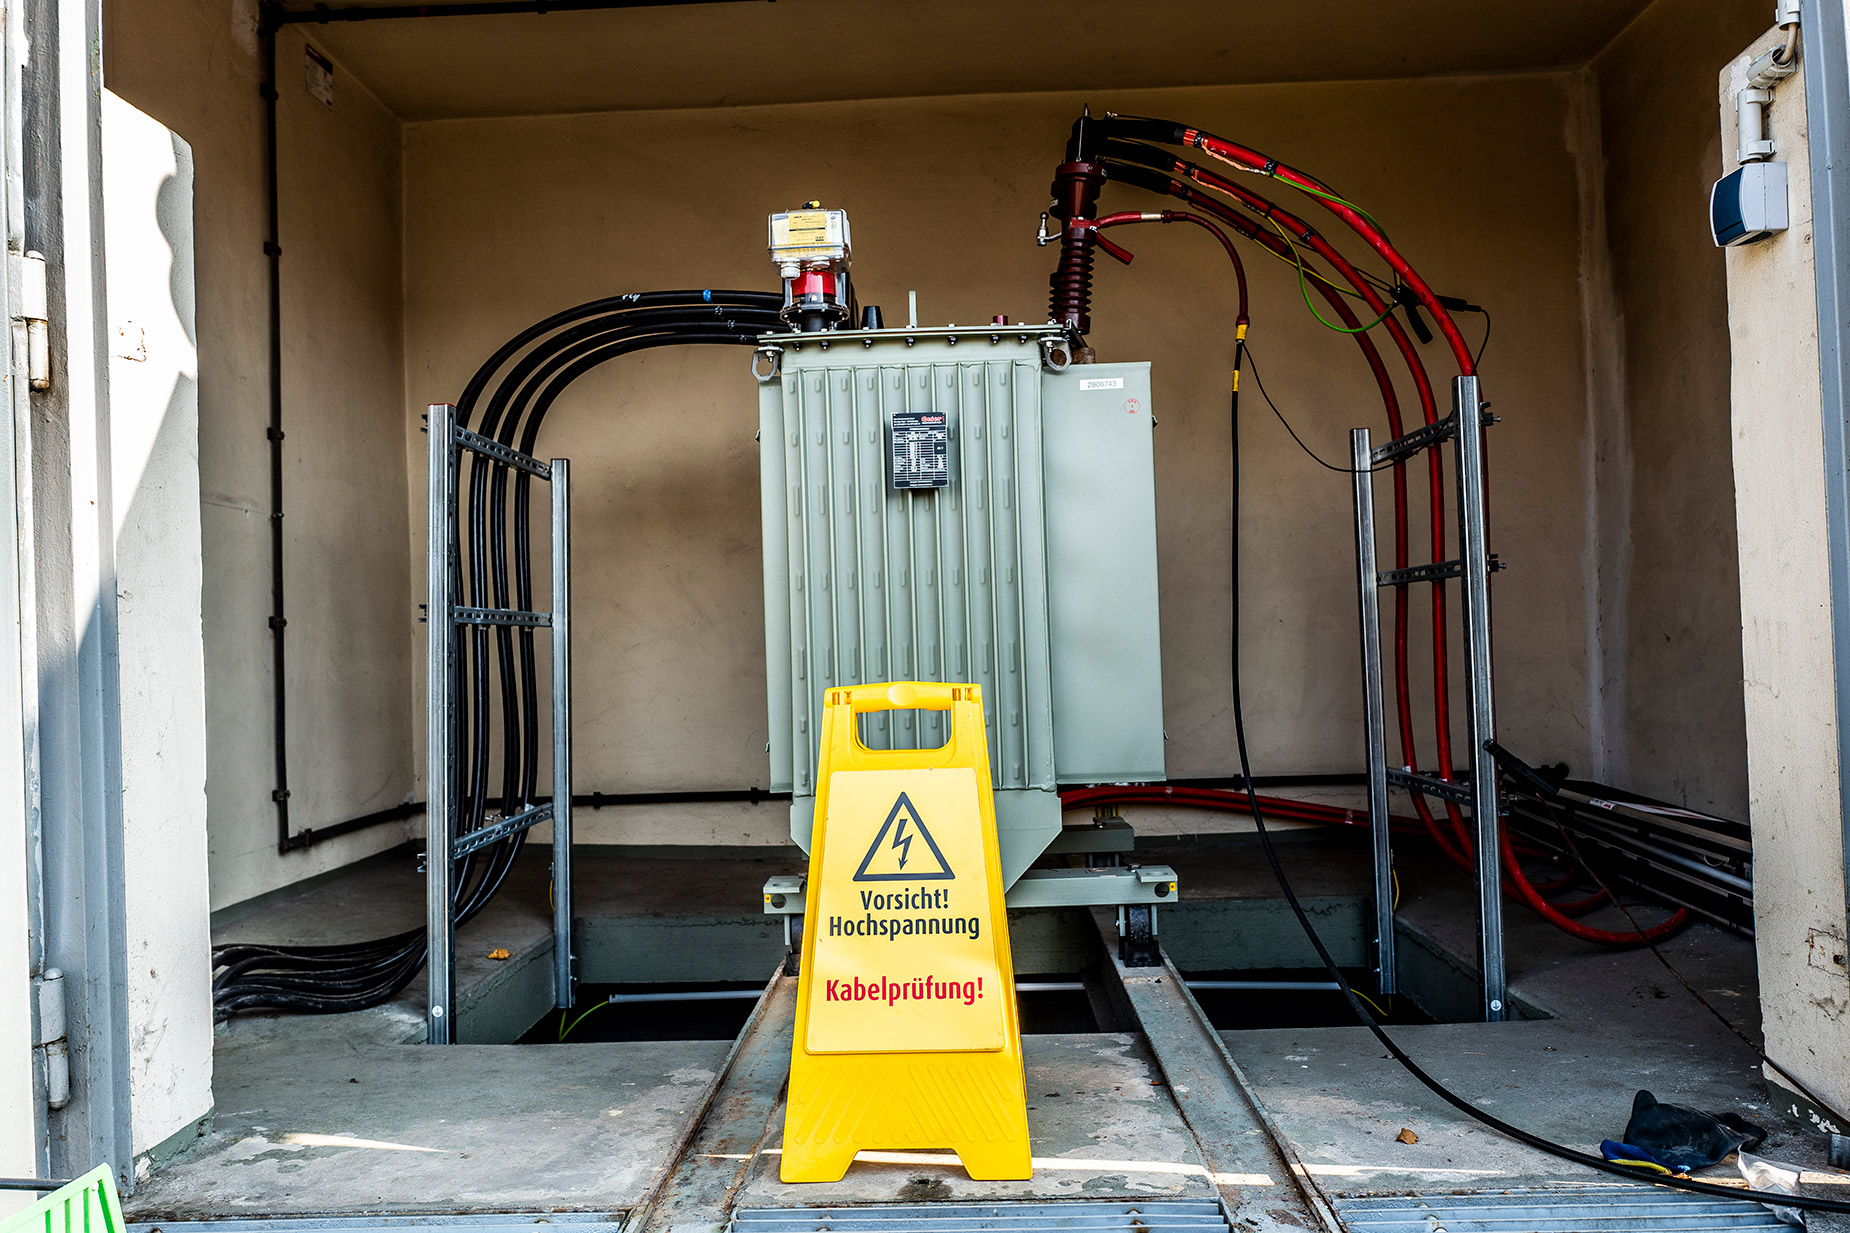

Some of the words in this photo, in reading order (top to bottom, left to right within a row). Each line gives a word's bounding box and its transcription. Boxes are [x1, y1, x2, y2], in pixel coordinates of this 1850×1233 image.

[860, 887, 949, 910] Vorsicht!
[829, 913, 980, 941] Hochspannung
[826, 974, 984, 1007] Kabelprüfung!
